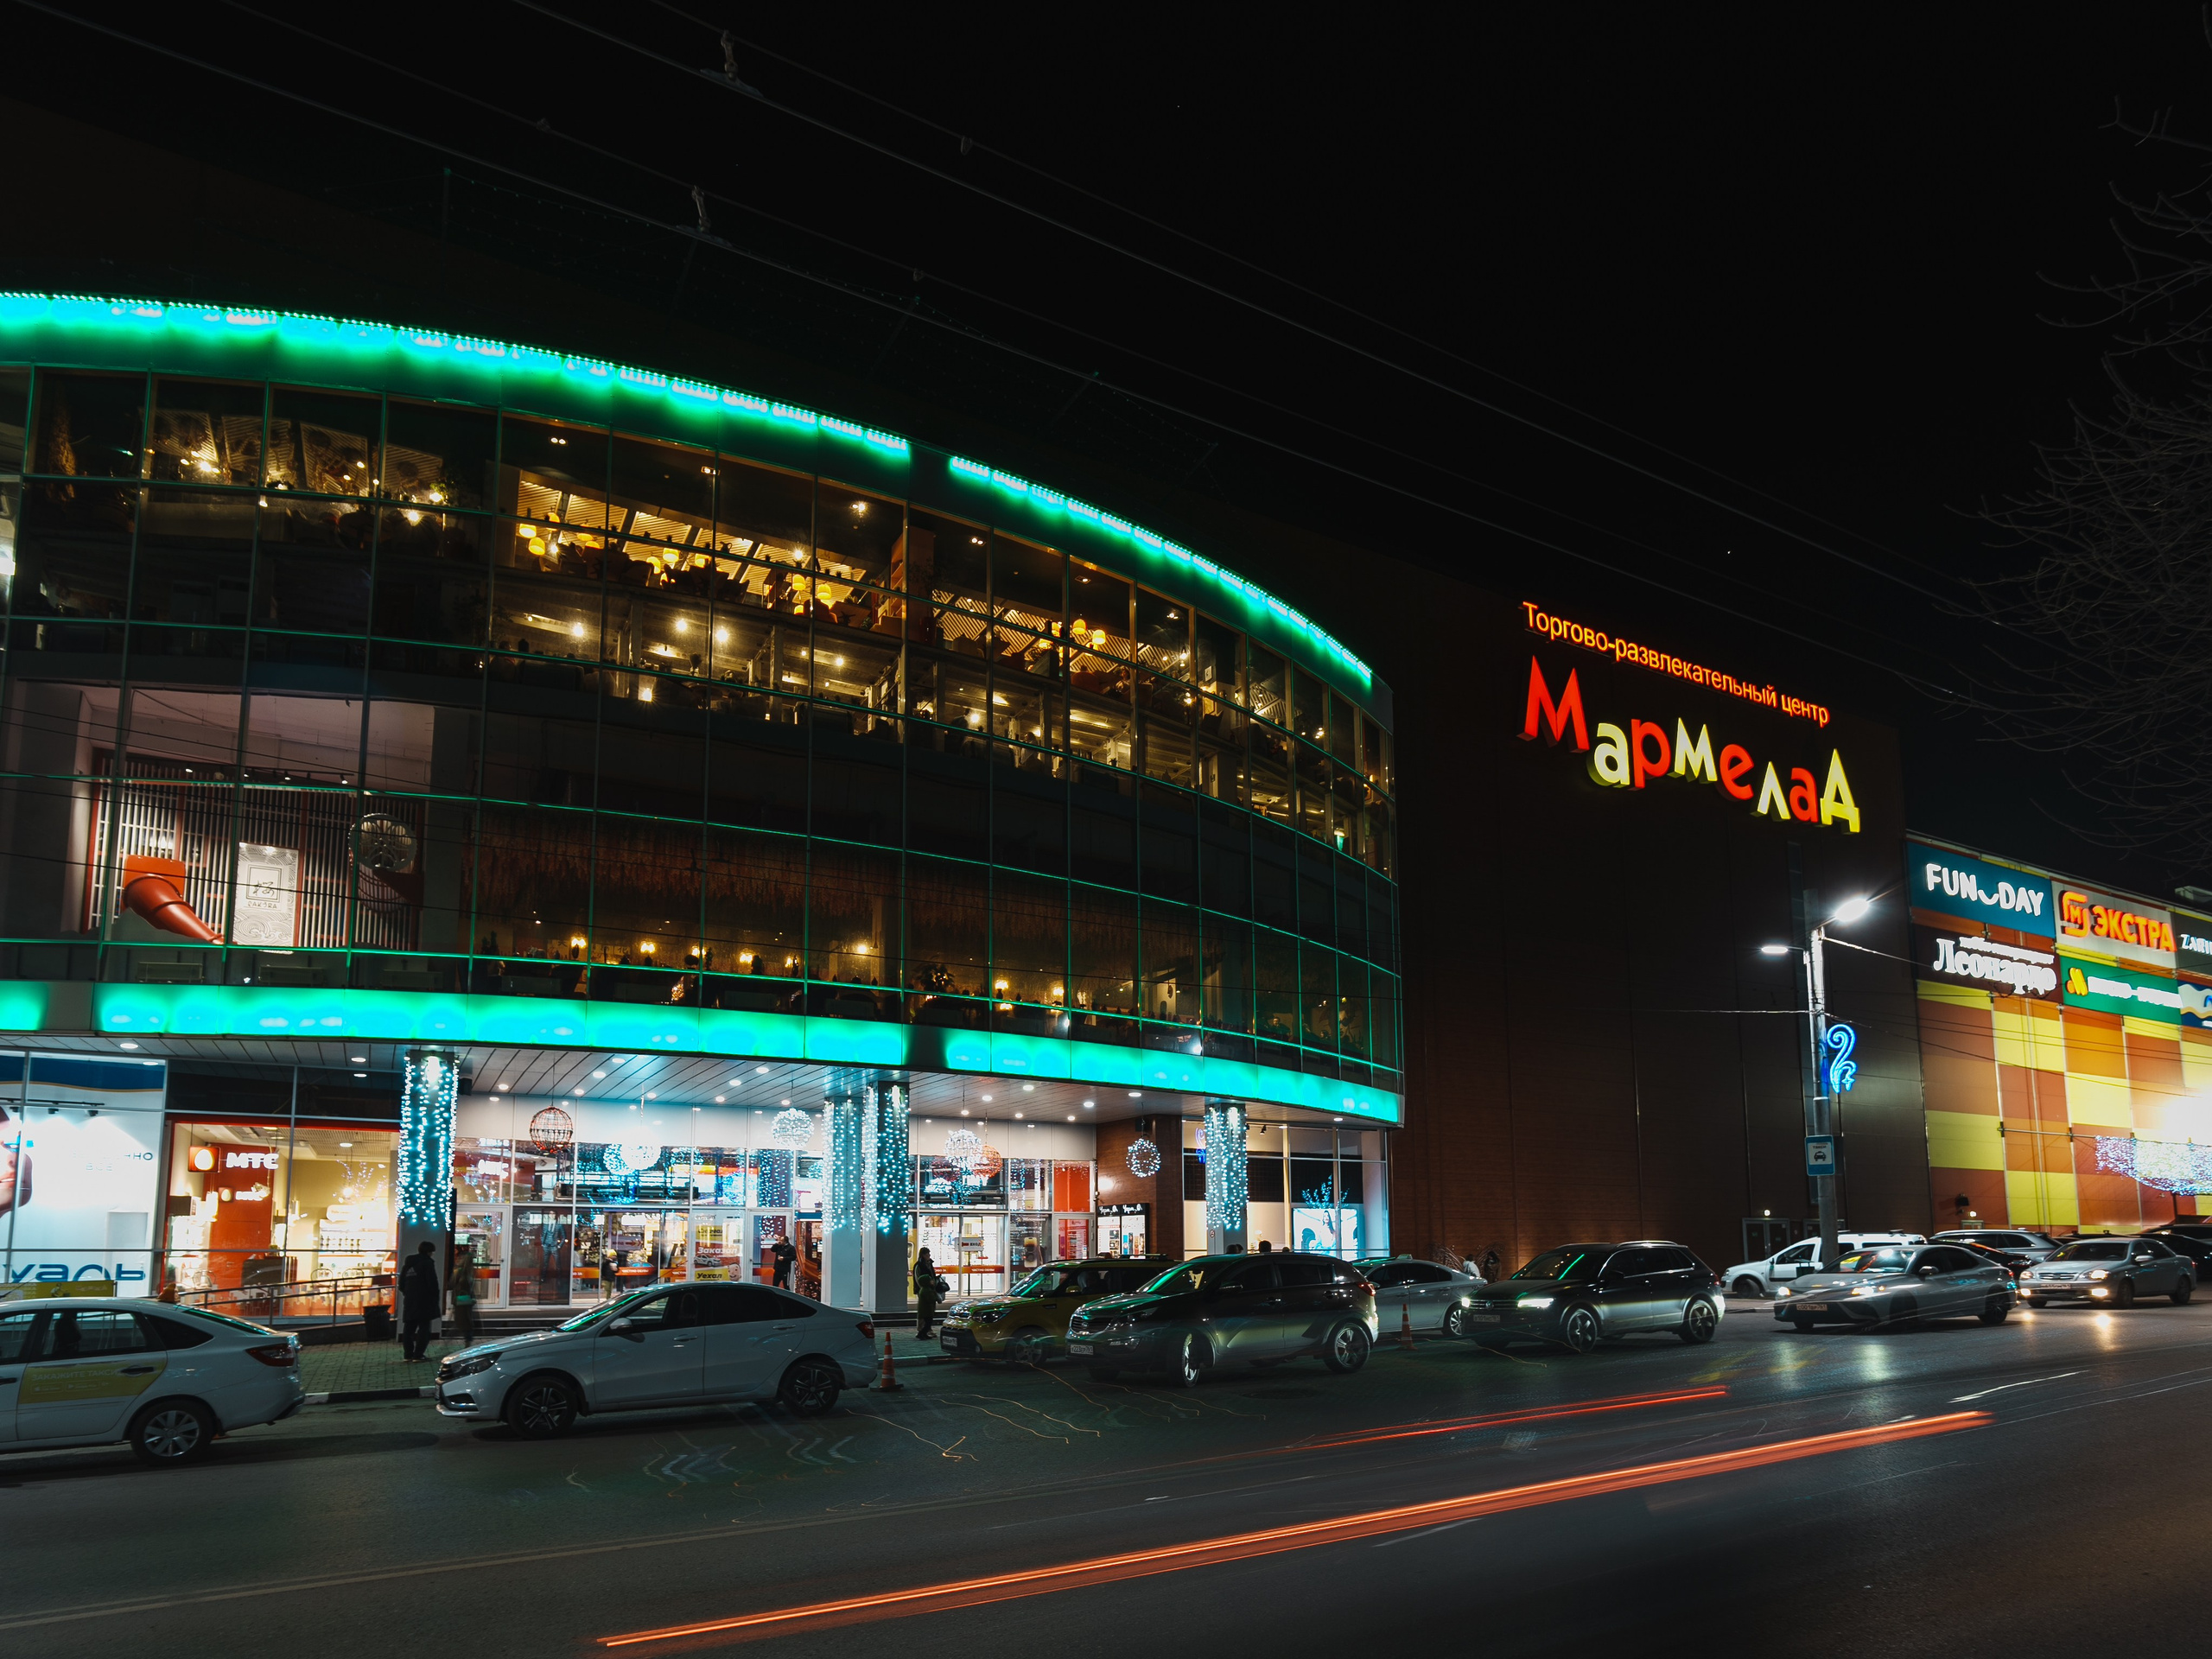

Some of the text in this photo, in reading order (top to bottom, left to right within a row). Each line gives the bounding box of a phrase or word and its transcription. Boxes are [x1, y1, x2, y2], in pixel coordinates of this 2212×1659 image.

[1522, 601, 1830, 728] Торгово-развлекательный центр
[1925, 863, 2044, 917] FUN DAY
[2090, 905, 2177, 953] ЭКСТРА
[1933, 938, 2056, 995] Леонардо
[226, 1152, 280, 1170] МТС
[32, 1370, 86, 1381] ЗАКАЖИТЕ
